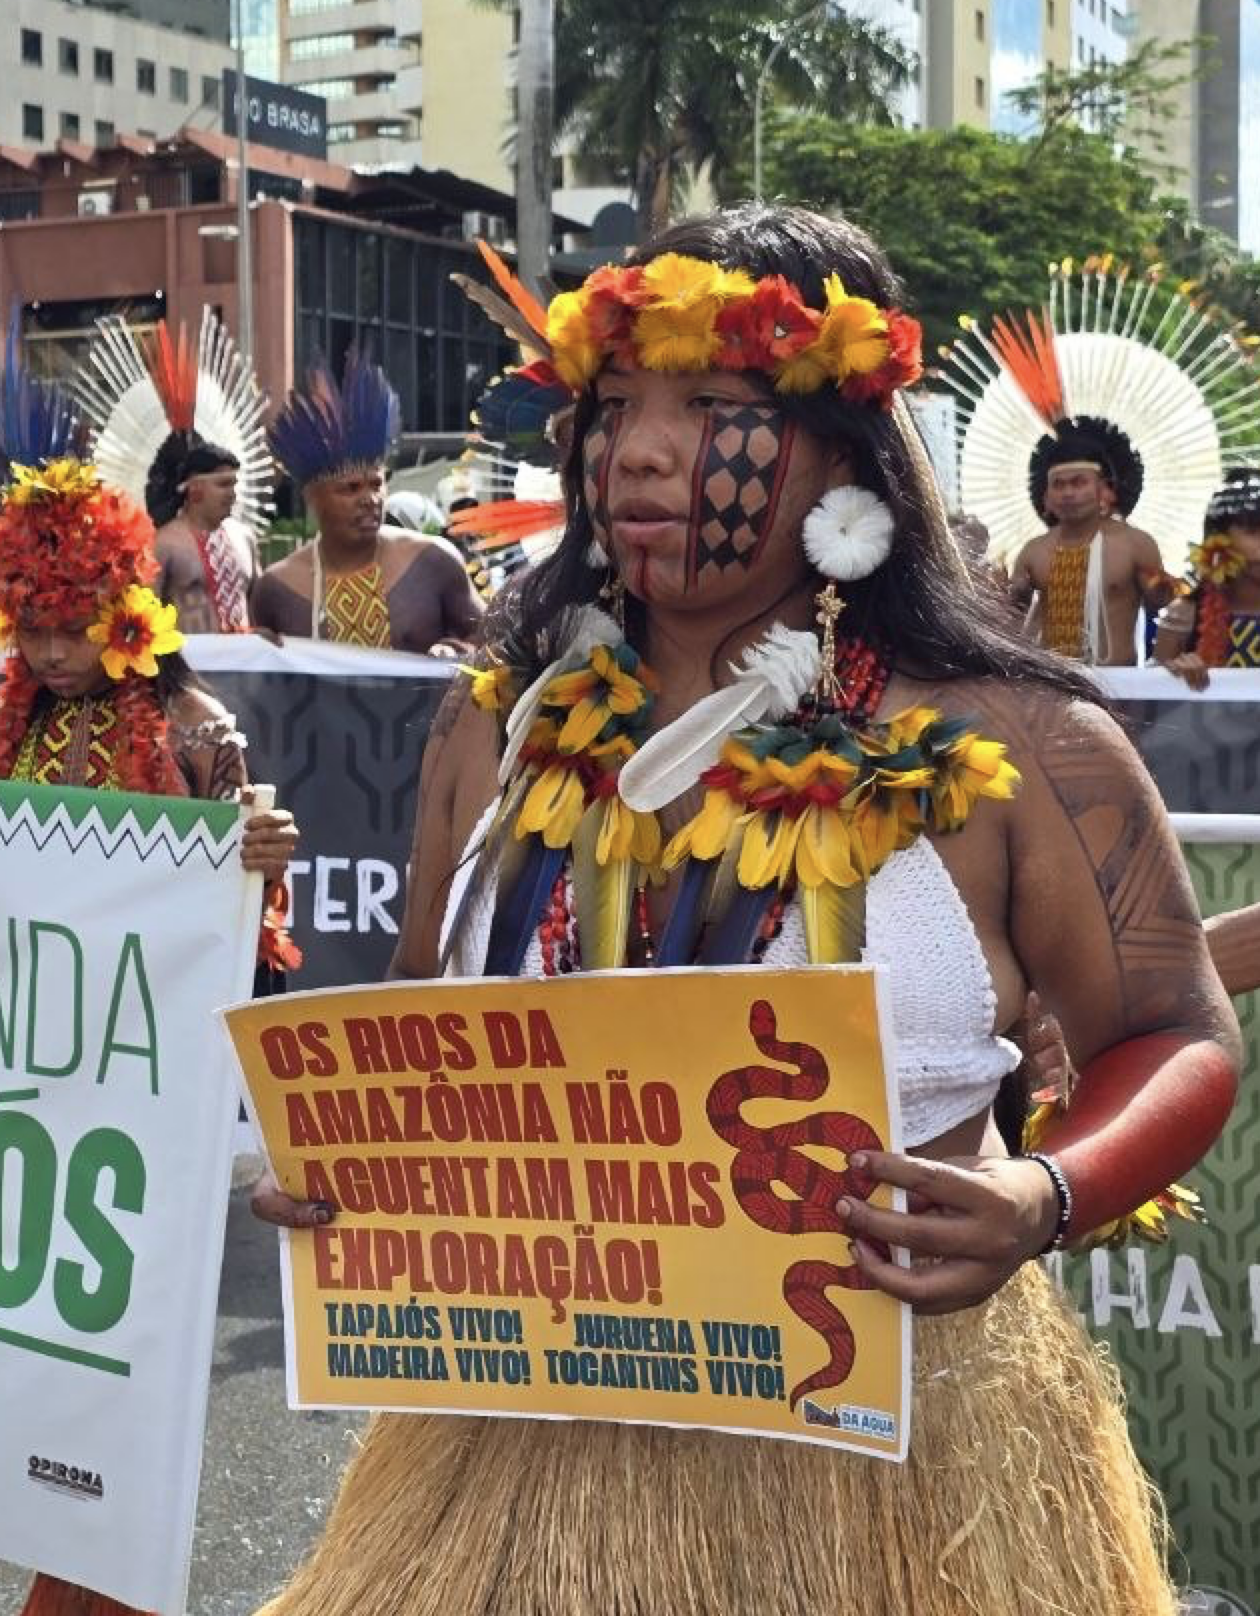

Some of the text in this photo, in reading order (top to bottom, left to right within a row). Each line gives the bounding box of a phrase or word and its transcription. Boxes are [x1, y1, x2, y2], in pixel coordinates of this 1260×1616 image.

[267, 101, 319, 136] BRASA
[283, 855, 411, 935] TER
[259, 1009, 567, 1081] OS RIOS DA
[285, 1069, 683, 1147] AMAZÔNIA NÃO
[302, 1155, 726, 1229] AGUENTAM MAIS
[313, 1223, 663, 1325] EXPLORAÇÃO!
[324, 1296, 524, 1345] TAPAJÓS VIVO!
[573, 1313, 782, 1362] JURUENA VIVO!
[327, 1343, 531, 1386] MADEIRA VIVO!
[544, 1350, 787, 1401] TOCANTINS VIVO!
